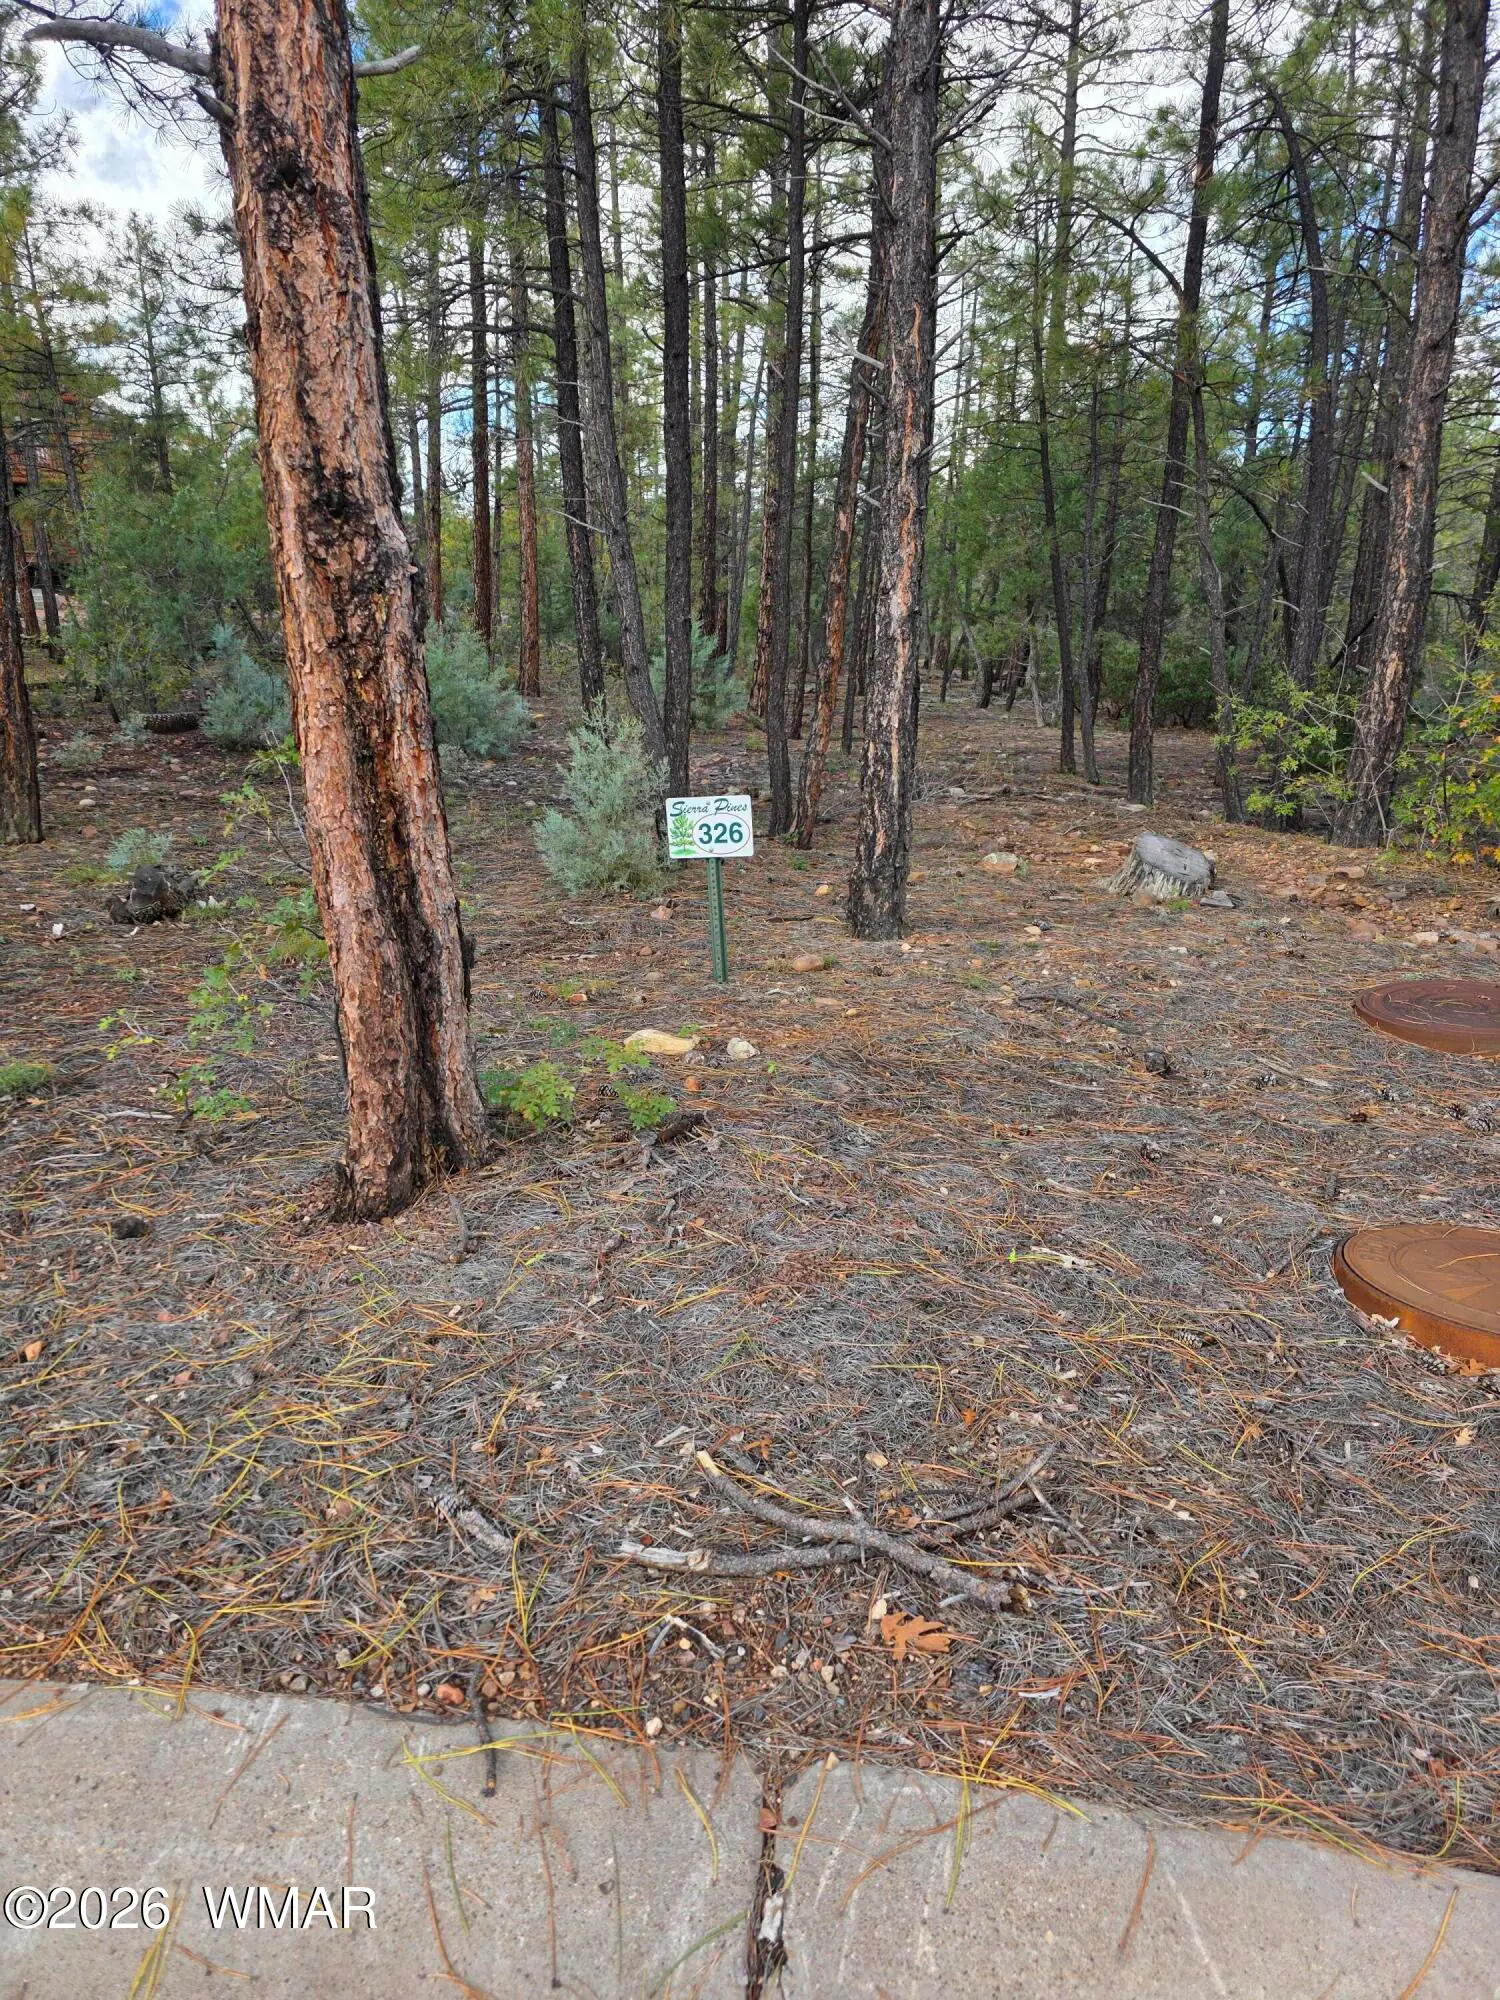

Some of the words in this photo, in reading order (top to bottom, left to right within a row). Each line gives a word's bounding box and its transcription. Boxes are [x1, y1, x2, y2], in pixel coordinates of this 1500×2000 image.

[670, 801, 709, 817] Sierra
[713, 798, 747, 815] Pines
[698, 822, 743, 844] 326
